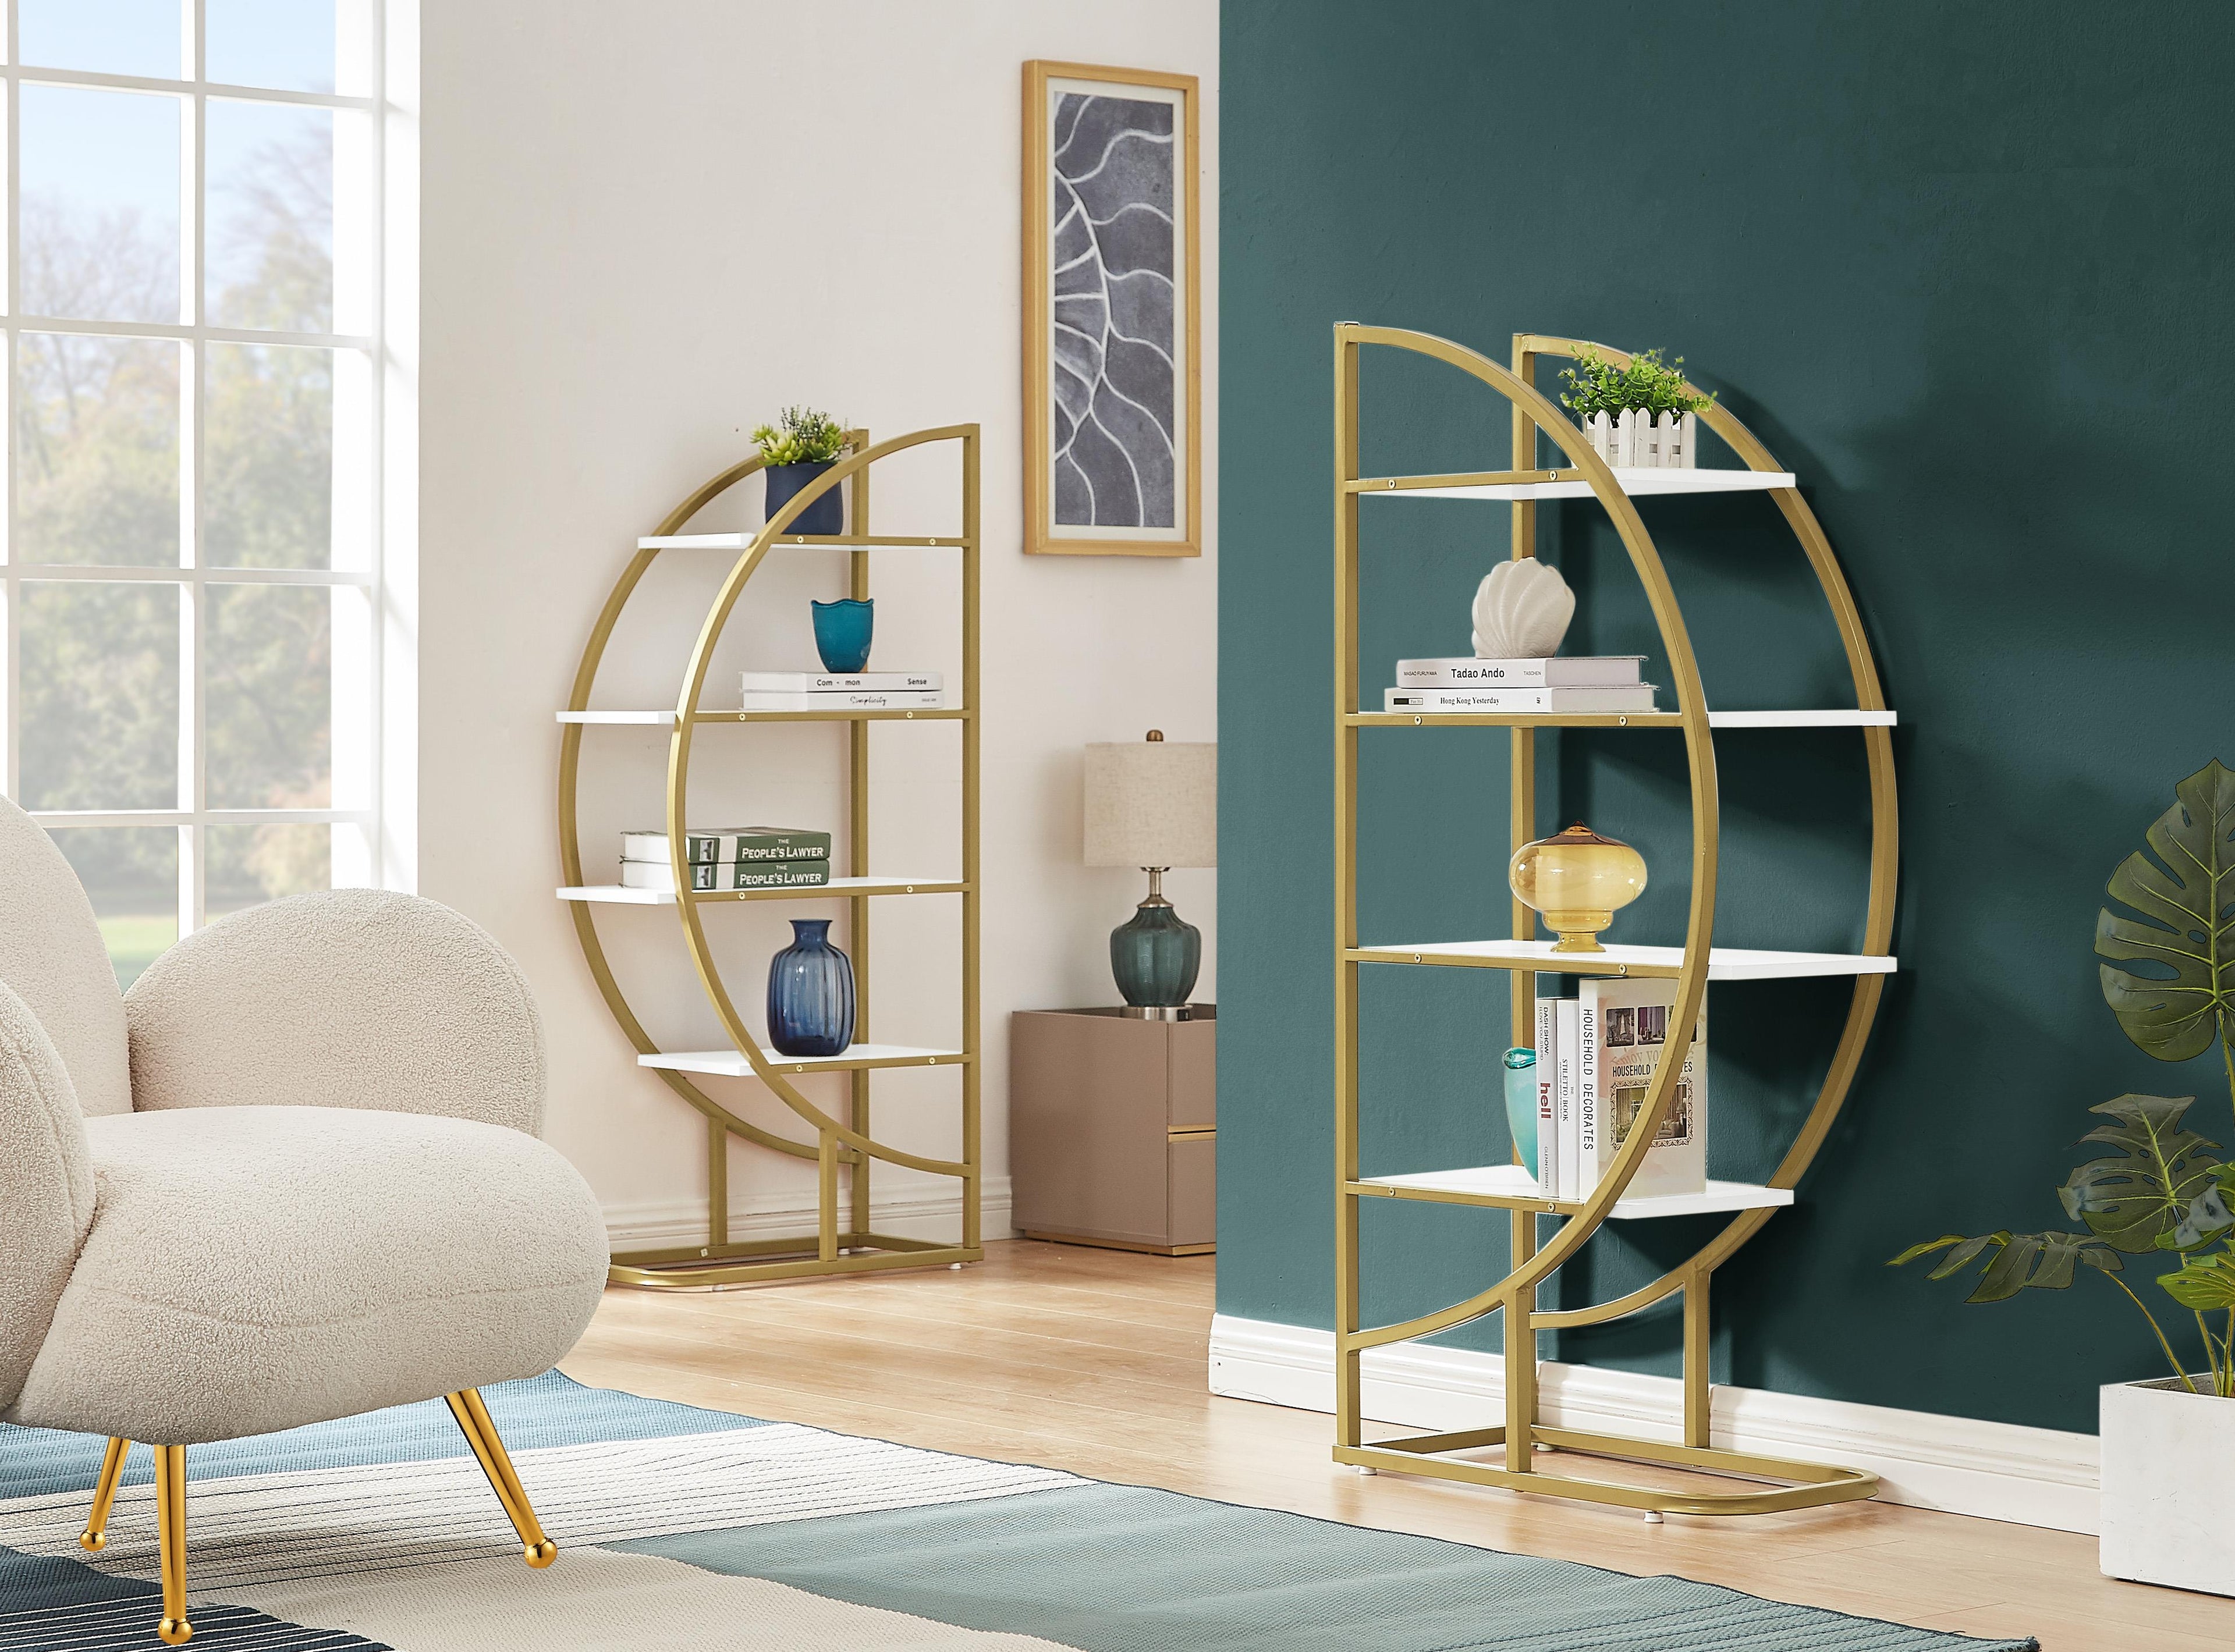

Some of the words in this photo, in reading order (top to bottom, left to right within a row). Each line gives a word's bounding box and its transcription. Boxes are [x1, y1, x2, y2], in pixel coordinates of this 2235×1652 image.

[1451, 668, 1478, 678] Tadao
[1481, 667, 1505, 678] Ando
[1440, 697, 1455, 705] Hong
[1456, 697, 1471, 705] Kong
[1472, 697, 1499, 705] Yesterday
[786, 846, 824, 858] LAWYER
[784, 872, 822, 884] LAWYER
[1583, 1009, 1593, 1075] HOUSEHOLD
[1612, 1064, 1651, 1077] HOUSEHOLD
[1540, 1083, 1551, 1118] hell
[1583, 1084, 1594, 1150] DECORATES
